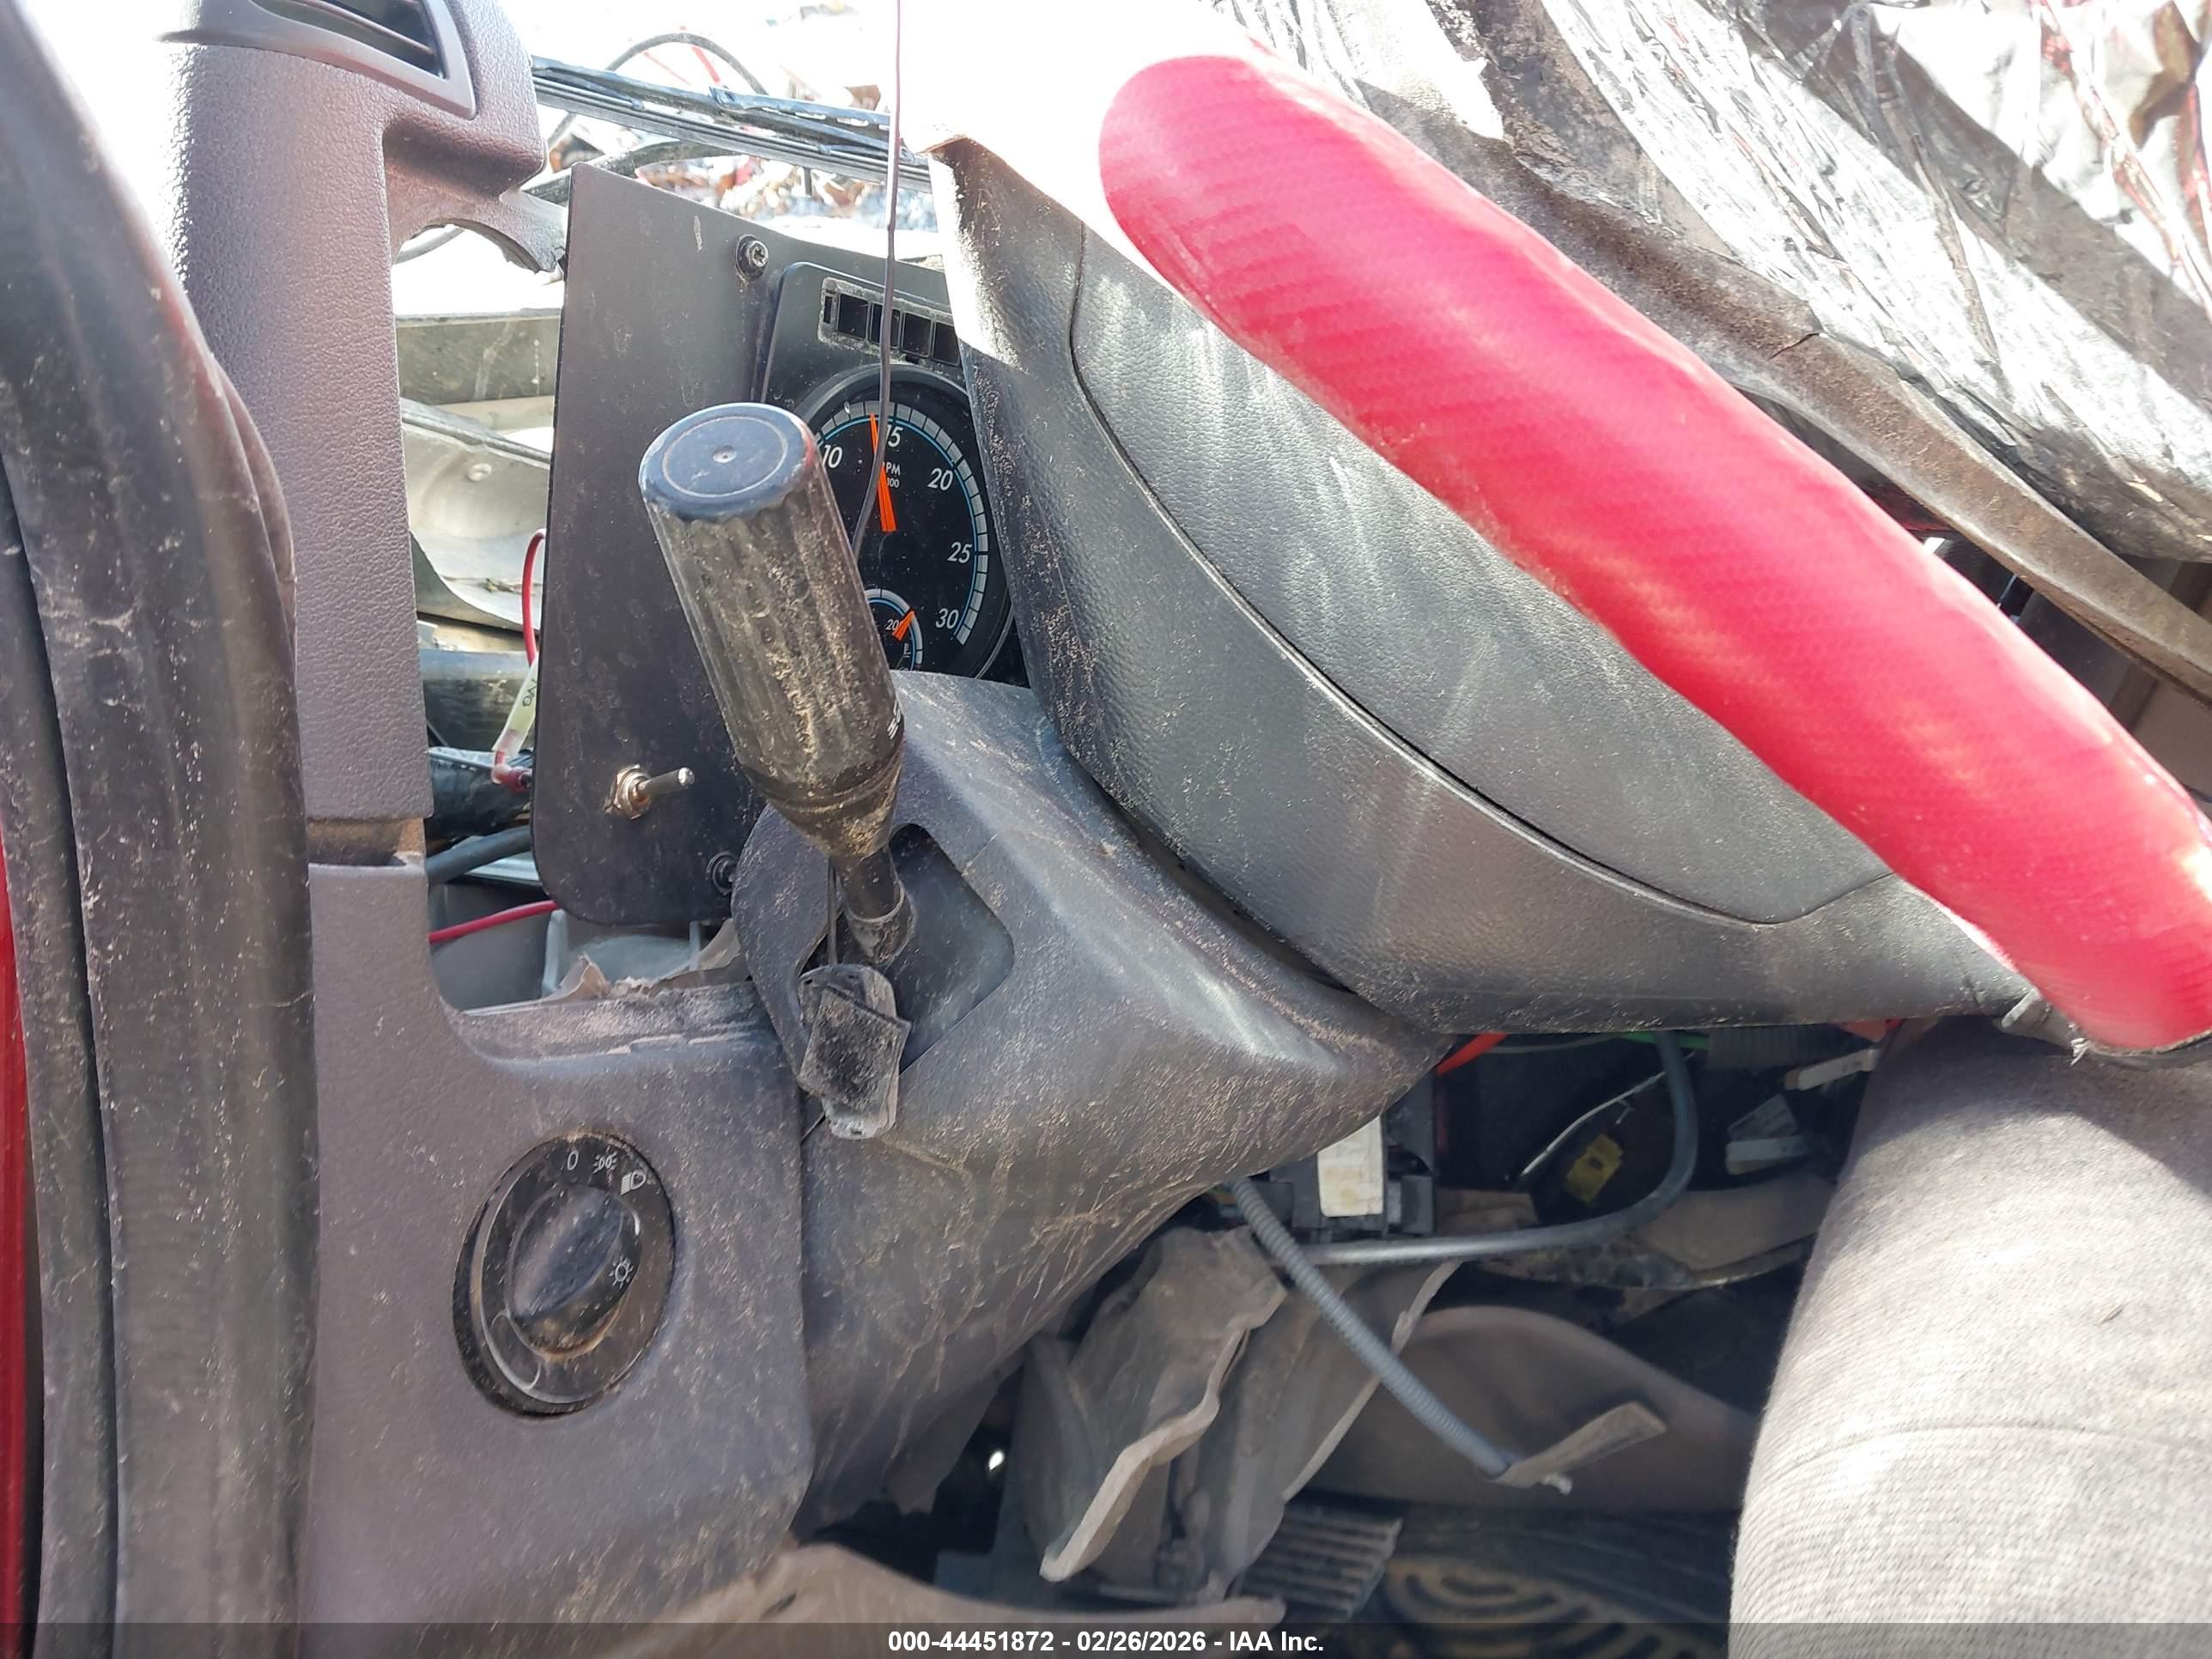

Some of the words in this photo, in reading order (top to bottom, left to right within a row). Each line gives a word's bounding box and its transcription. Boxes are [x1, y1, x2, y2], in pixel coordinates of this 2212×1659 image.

[822, 444, 843, 469] 10
[882, 461, 901, 476] PM
[927, 467, 954, 491] 20
[946, 541, 973, 564] 25
[935, 608, 959, 629] 30
